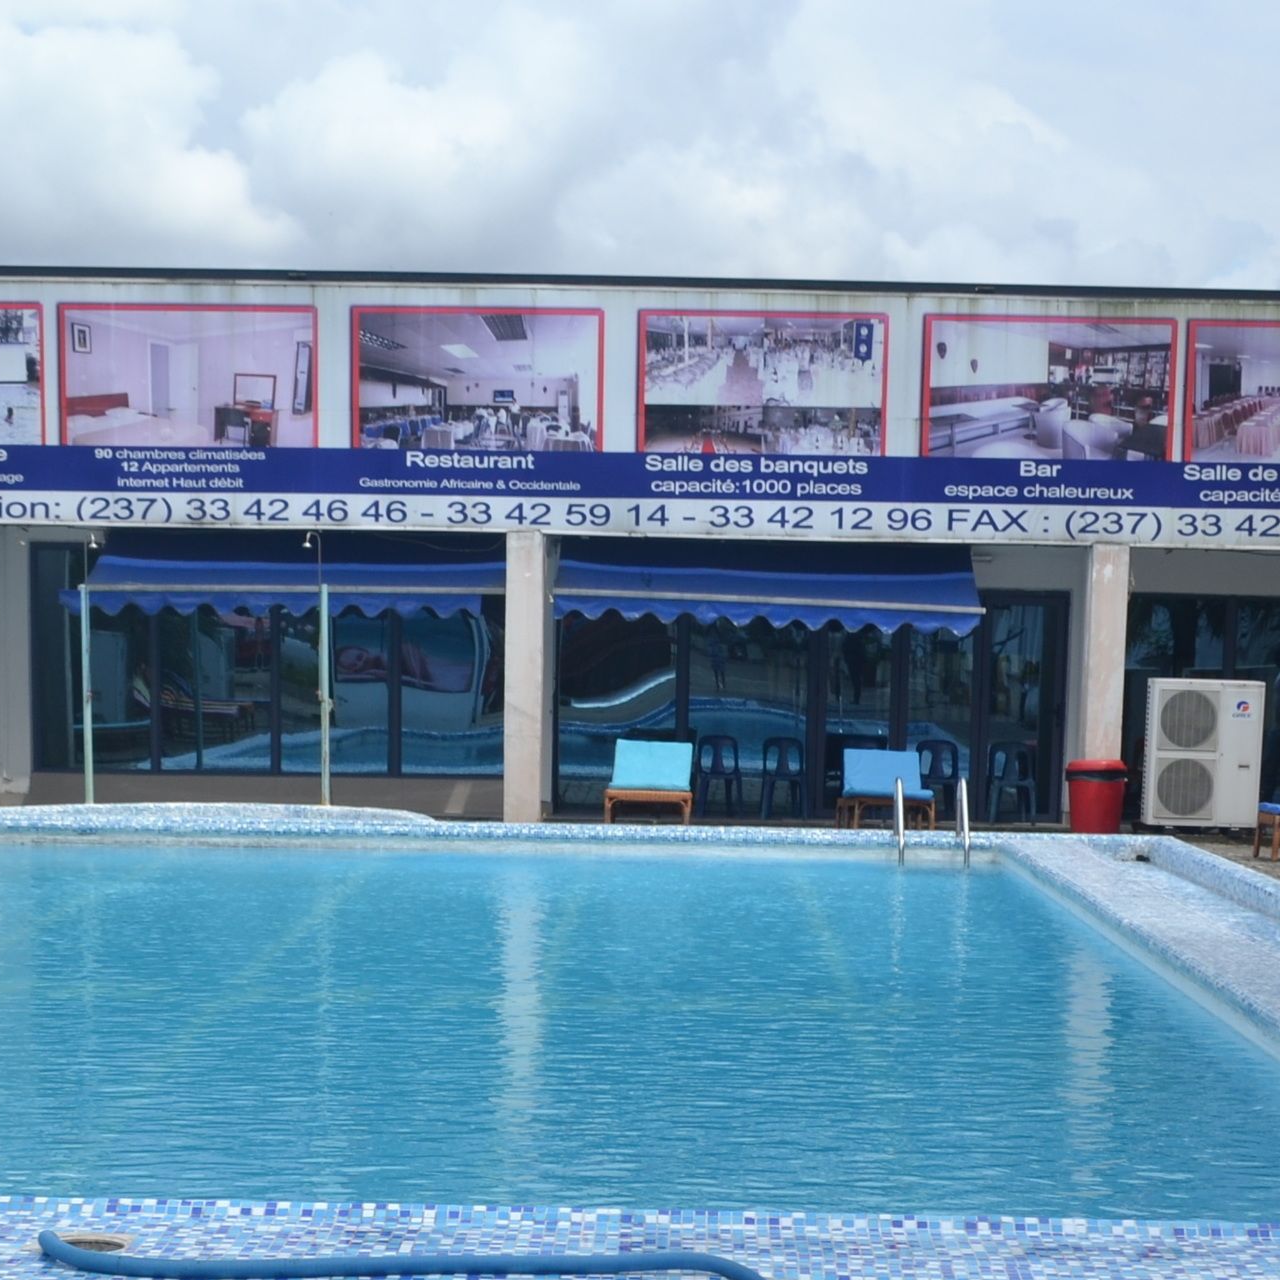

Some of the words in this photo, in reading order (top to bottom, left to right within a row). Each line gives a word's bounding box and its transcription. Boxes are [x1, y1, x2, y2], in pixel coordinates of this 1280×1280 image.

[95, 449, 112, 458] 90
[116, 449, 185, 459] chambres
[189, 450, 265, 459] climatisées
[407, 451, 534, 469] Restaurant
[122, 462, 138, 471] 12
[142, 462, 239, 474] Appartements
[646, 455, 703, 471] Salle
[710, 457, 753, 472] des
[761, 457, 868, 476] banquets
[1020, 461, 1061, 476] Bar
[1184, 465, 1241, 480] Salle
[1249, 466, 1277, 481] de
[173, 478, 206, 487] Haut
[210, 478, 243, 487] débit
[360, 478, 437, 488] Gastronomie
[440, 479, 494, 489] Africaine
[496, 480, 505, 490] &
[509, 480, 580, 490] Occidentale
[651, 479, 791, 495] capacité:1000
[797, 480, 861, 497] places
[944, 486, 1018, 499] espace
[1024, 484, 1133, 499] chaleureux
[77, 497, 172, 523] (237)
[186, 499, 230, 520] 33
[244, 499, 289, 521] 42
[302, 500, 348, 522] 46
[362, 501, 407, 523] 46
[448, 502, 491, 524] 33
[505, 503, 550, 525] 42
[566, 504, 610, 526] 59
[628, 504, 669, 526] 14
[709, 506, 754, 528] 33
[767, 506, 813, 529] 42
[831, 508, 872, 530] 12
[887, 509, 932, 531] 96
[948, 509, 1027, 532] FAX
[1063, 511, 1161, 541] (237)
[1178, 514, 1222, 536] 33
[1235, 515, 1280, 537] 42
